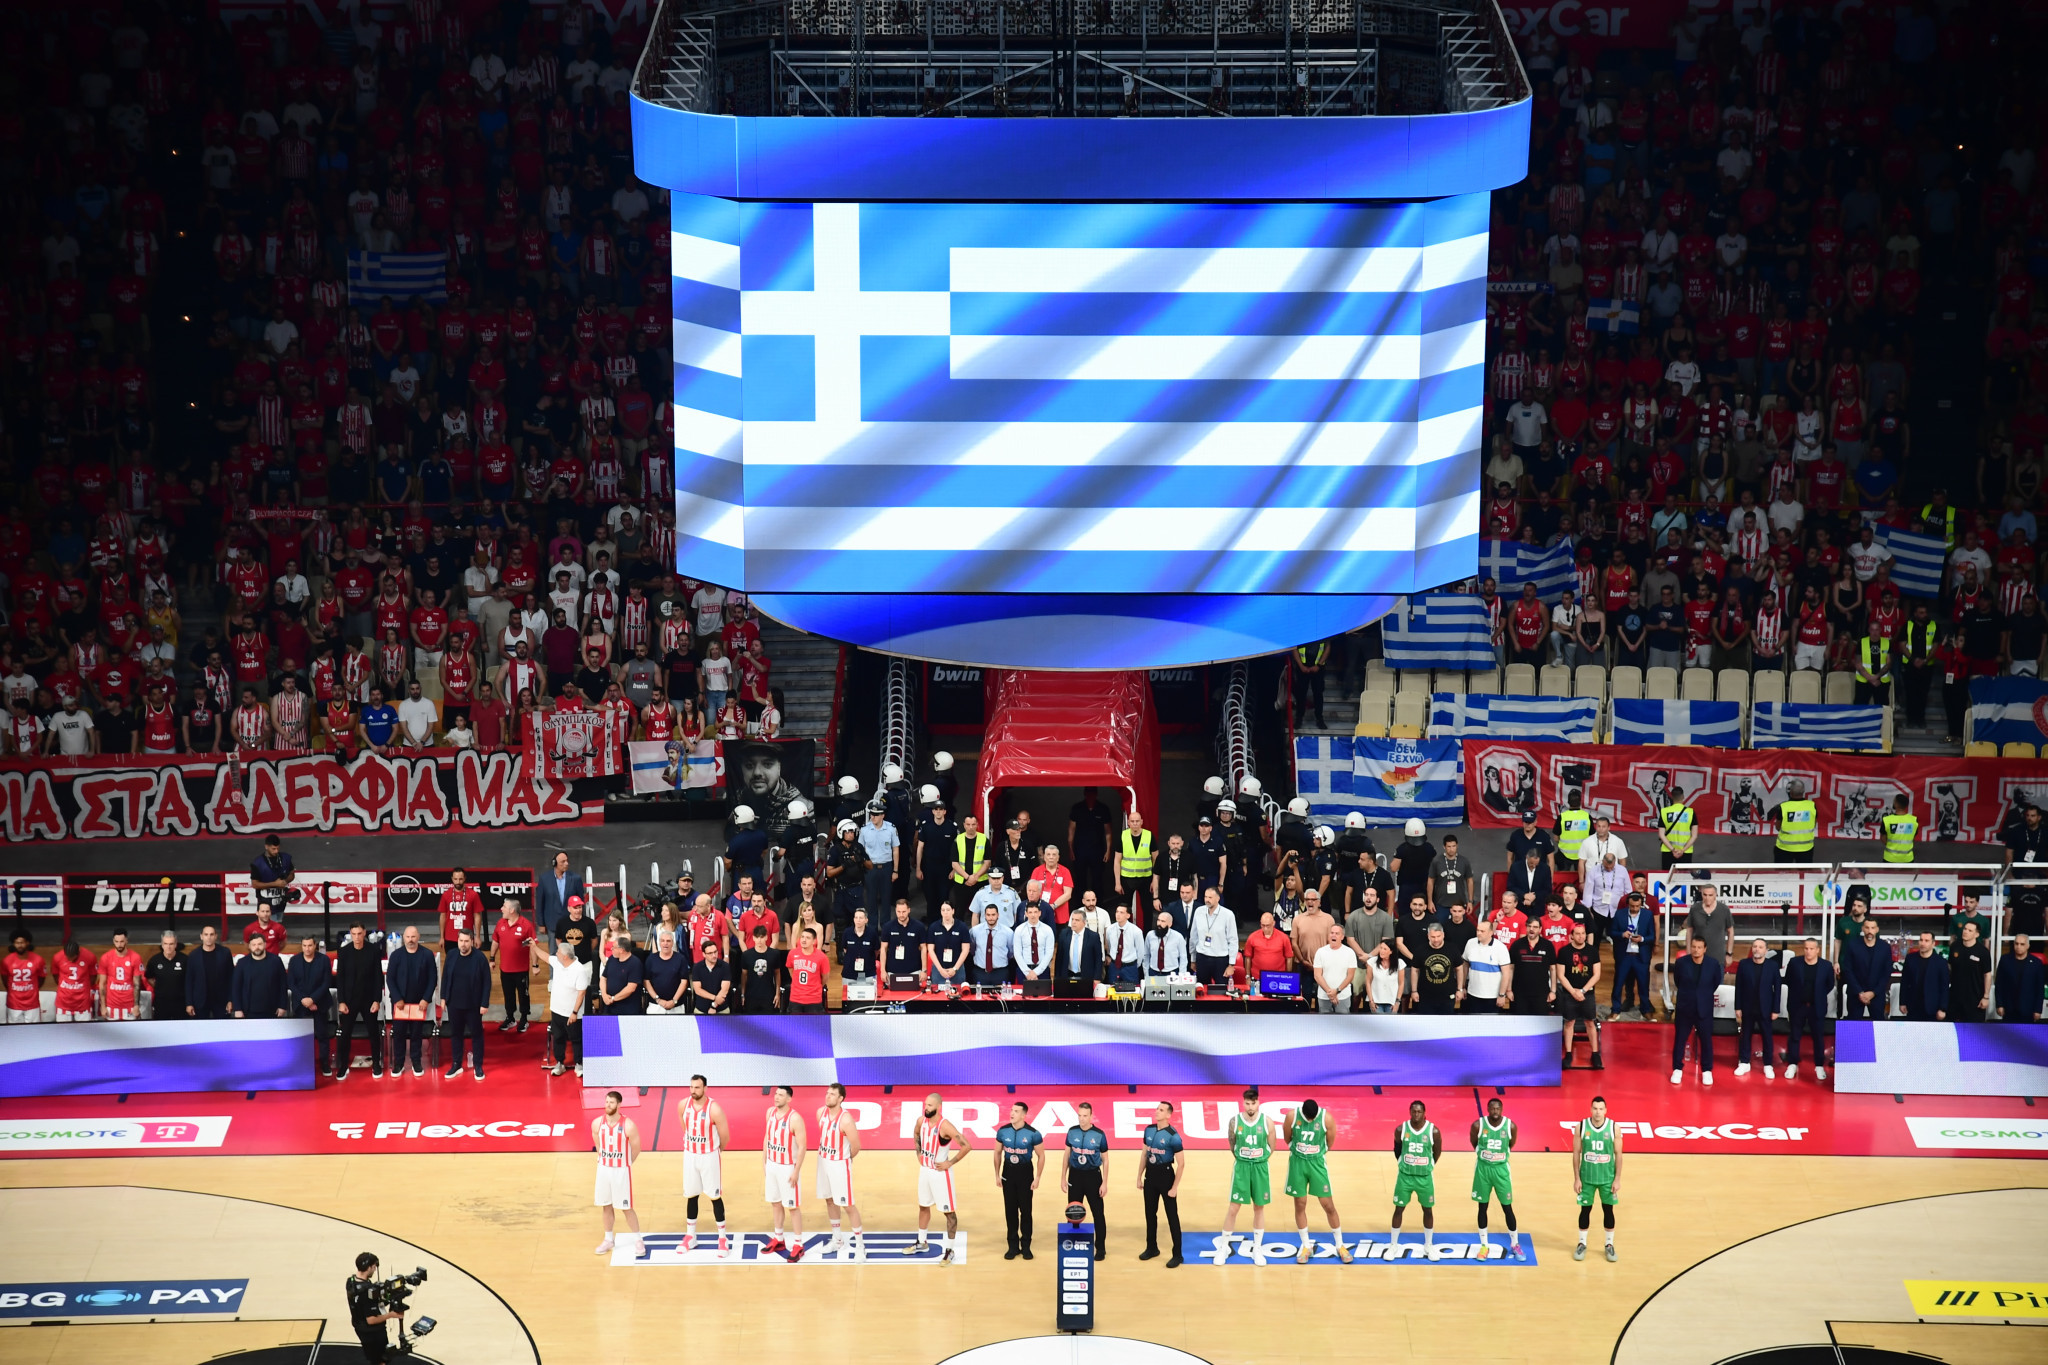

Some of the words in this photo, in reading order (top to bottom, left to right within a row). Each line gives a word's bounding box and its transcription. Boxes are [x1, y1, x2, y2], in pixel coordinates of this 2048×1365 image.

[1609, 589, 1628, 597] bwin
[1518, 627, 1538, 635] bwin
[933, 666, 981, 682] bwin
[632, 682, 648, 690] bwin
[543, 713, 605, 731] ΟΛΥΜΠΙΑΚΟΣ
[654, 720, 666, 728] 94
[151, 733, 171, 741] bwin
[651, 730, 670, 738] bwin
[74, 768, 199, 838] ΣΤΑ
[206, 752, 448, 832] ΑΔΕΡΦΙΑ
[91, 876, 197, 912] bwin
[1690, 885, 1764, 898] MRINE
[13, 969, 32, 981] 22
[68, 967, 77, 980] 3
[116, 967, 124, 980] 8
[799, 971, 807, 984] 8
[11, 982, 34, 991] bwin
[60, 981, 85, 992] bwin
[110, 982, 131, 991] bwin
[374, 1120, 575, 1140] FlexCar
[1621, 1121, 1809, 1140] FlexCar
[1245, 1134, 1257, 1145] 41
[1301, 1131, 1314, 1141] 77
[767, 1141, 786, 1153] bwin
[1408, 1142, 1424, 1153] 25
[1487, 1139, 1502, 1149] 22
[1592, 1140, 1604, 1150] 10
[601, 1150, 623, 1159] bwin
[148, 1286, 243, 1305] PAY
